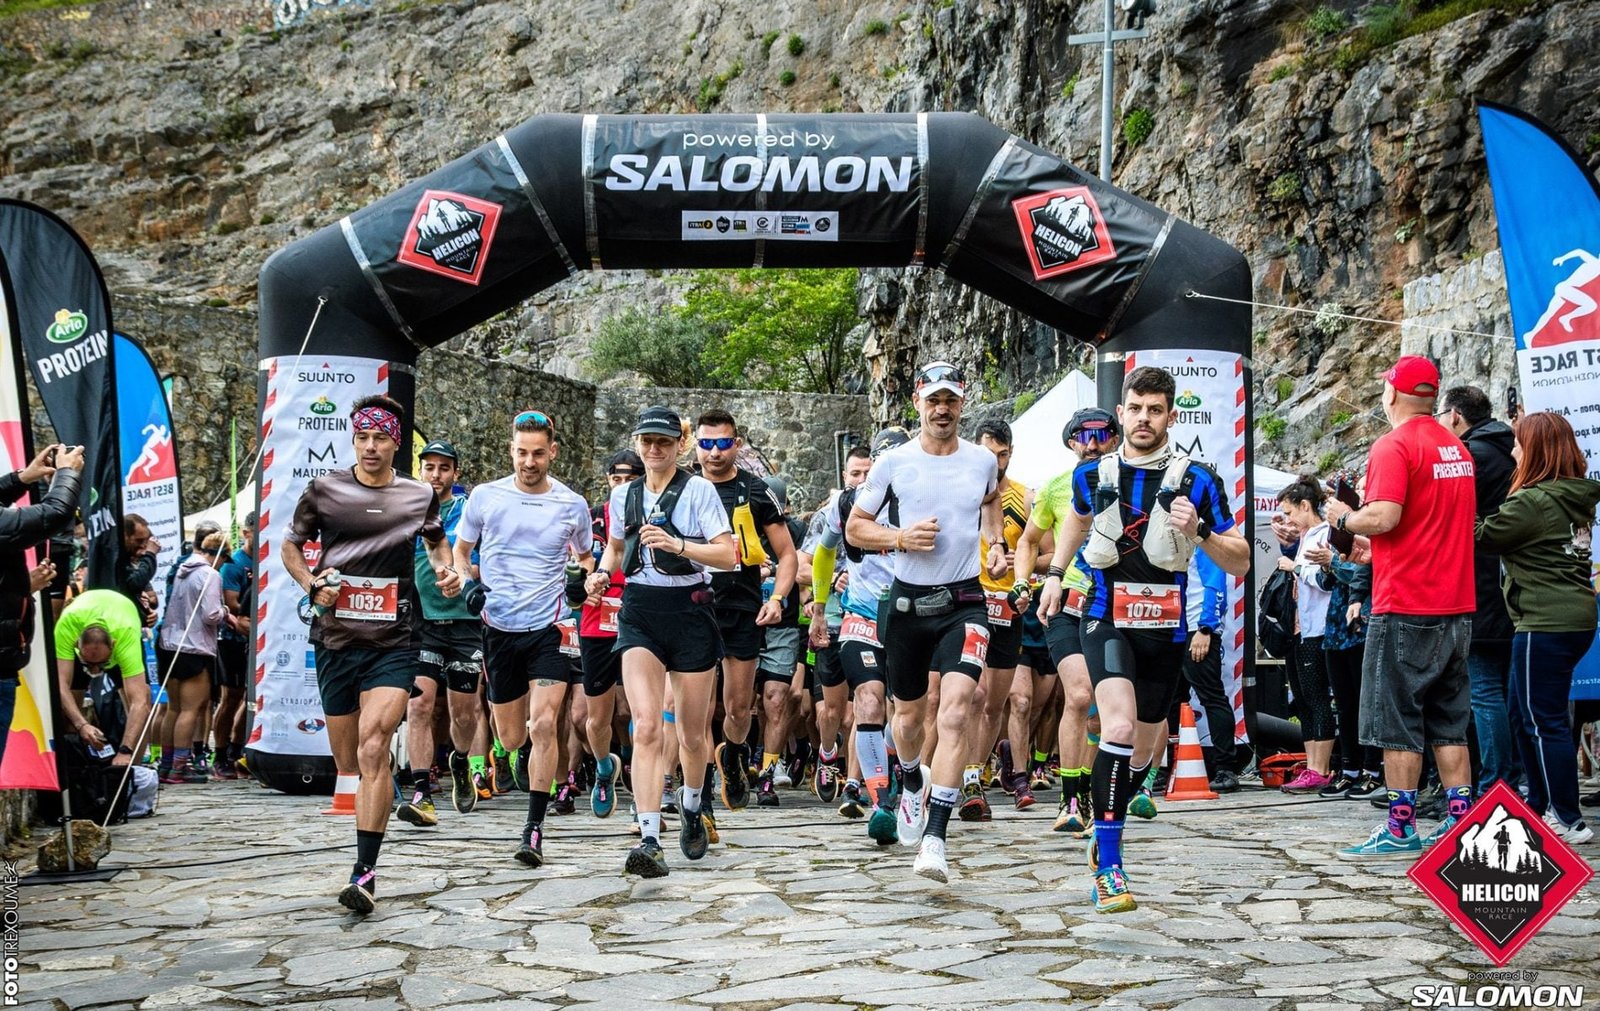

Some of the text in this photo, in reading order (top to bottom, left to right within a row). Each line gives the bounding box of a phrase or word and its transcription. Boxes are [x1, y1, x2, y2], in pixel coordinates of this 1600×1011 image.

[683, 132, 835, 150] powered by
[605, 154, 913, 192] SALOMON
[432, 228, 480, 260] HELICON
[1034, 224, 1082, 256] HELICON
[55, 319, 82, 338] Arla
[37, 330, 109, 384] PROTEIN
[298, 372, 355, 384] SUUNTO
[314, 401, 333, 412] Arla
[1179, 396, 1198, 405] Arla
[298, 417, 347, 432] PROTEIN
[1176, 411, 1212, 425] OTEIN
[1254, 537, 1272, 554] ΡΟΣ
[348, 593, 384, 611] 1032
[986, 603, 1002, 617] 89
[1126, 603, 1162, 618] 1076
[849, 622, 874, 637] 1190
[1109, 760, 1120, 810] COMPRESSPORT
